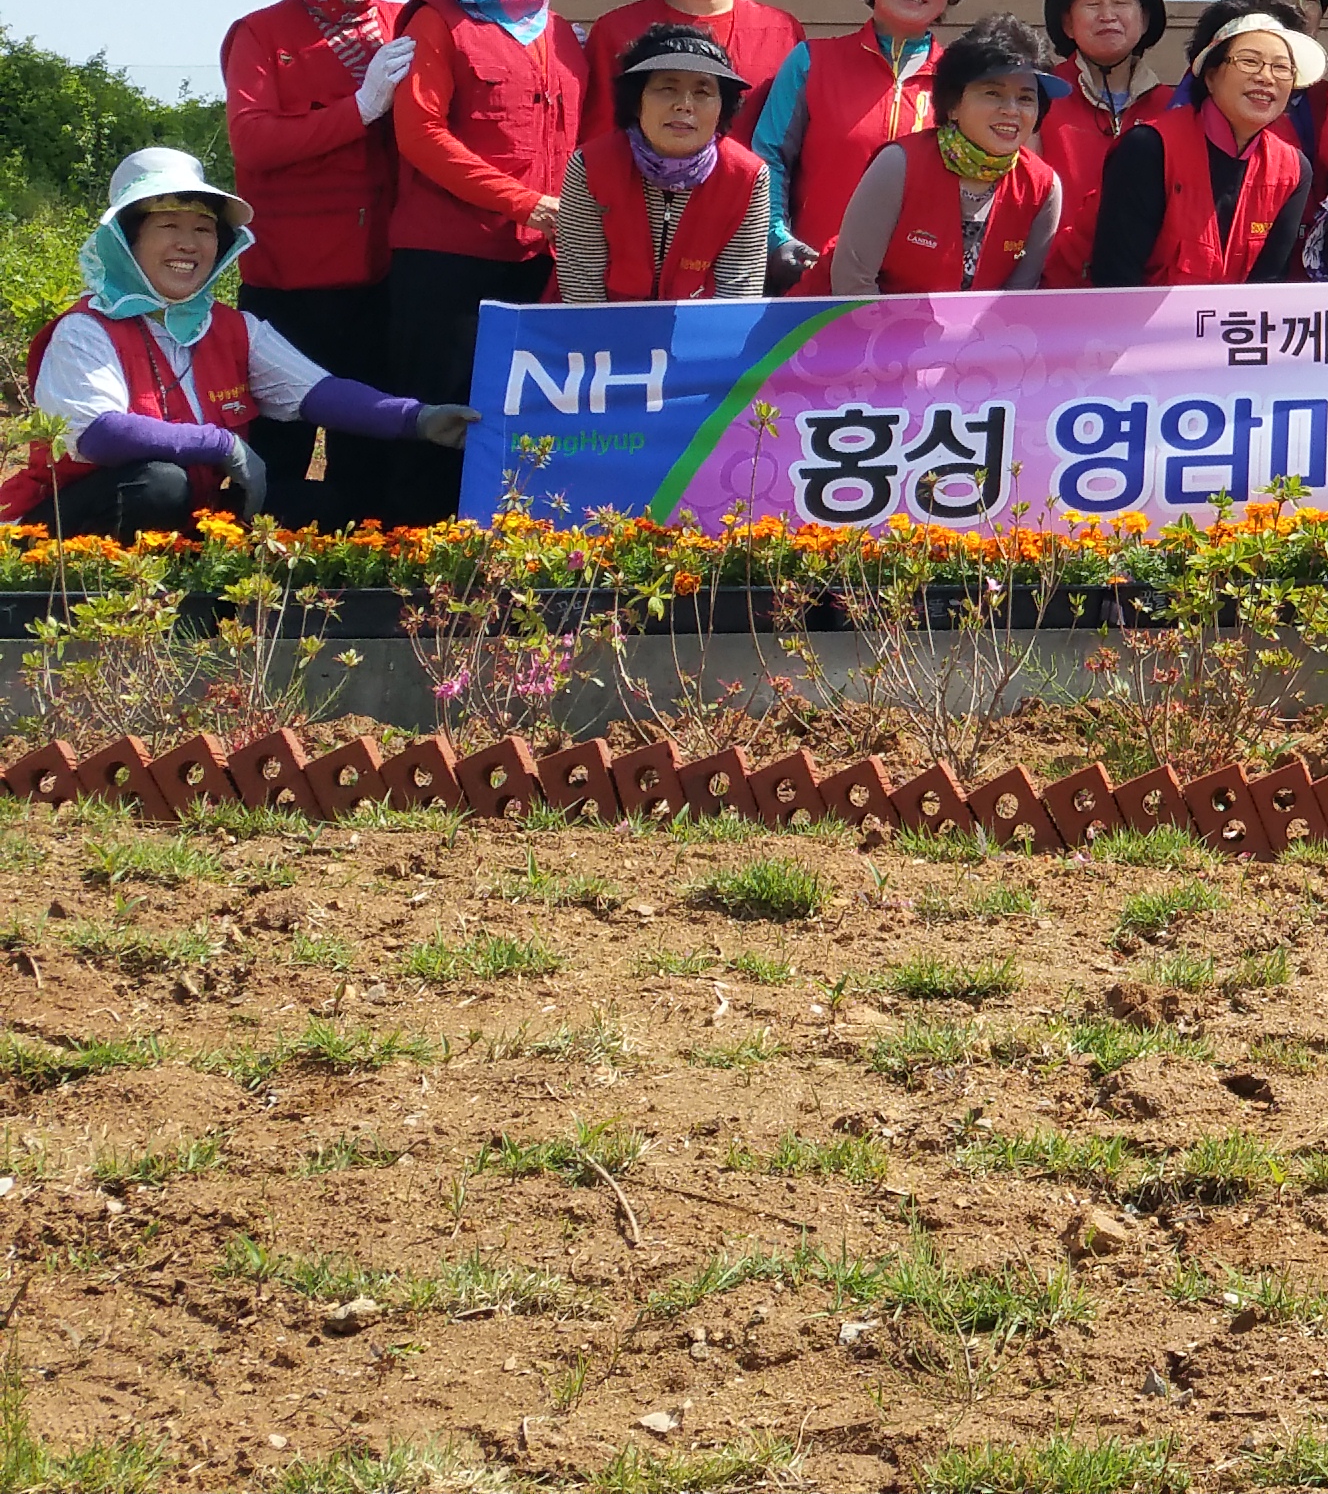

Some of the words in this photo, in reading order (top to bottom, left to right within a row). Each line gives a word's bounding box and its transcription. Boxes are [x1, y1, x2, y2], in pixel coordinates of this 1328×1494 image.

[503, 348, 668, 417] NH
[511, 428, 646, 457] NngHyup
[799, 404, 1007, 523] 홍성
